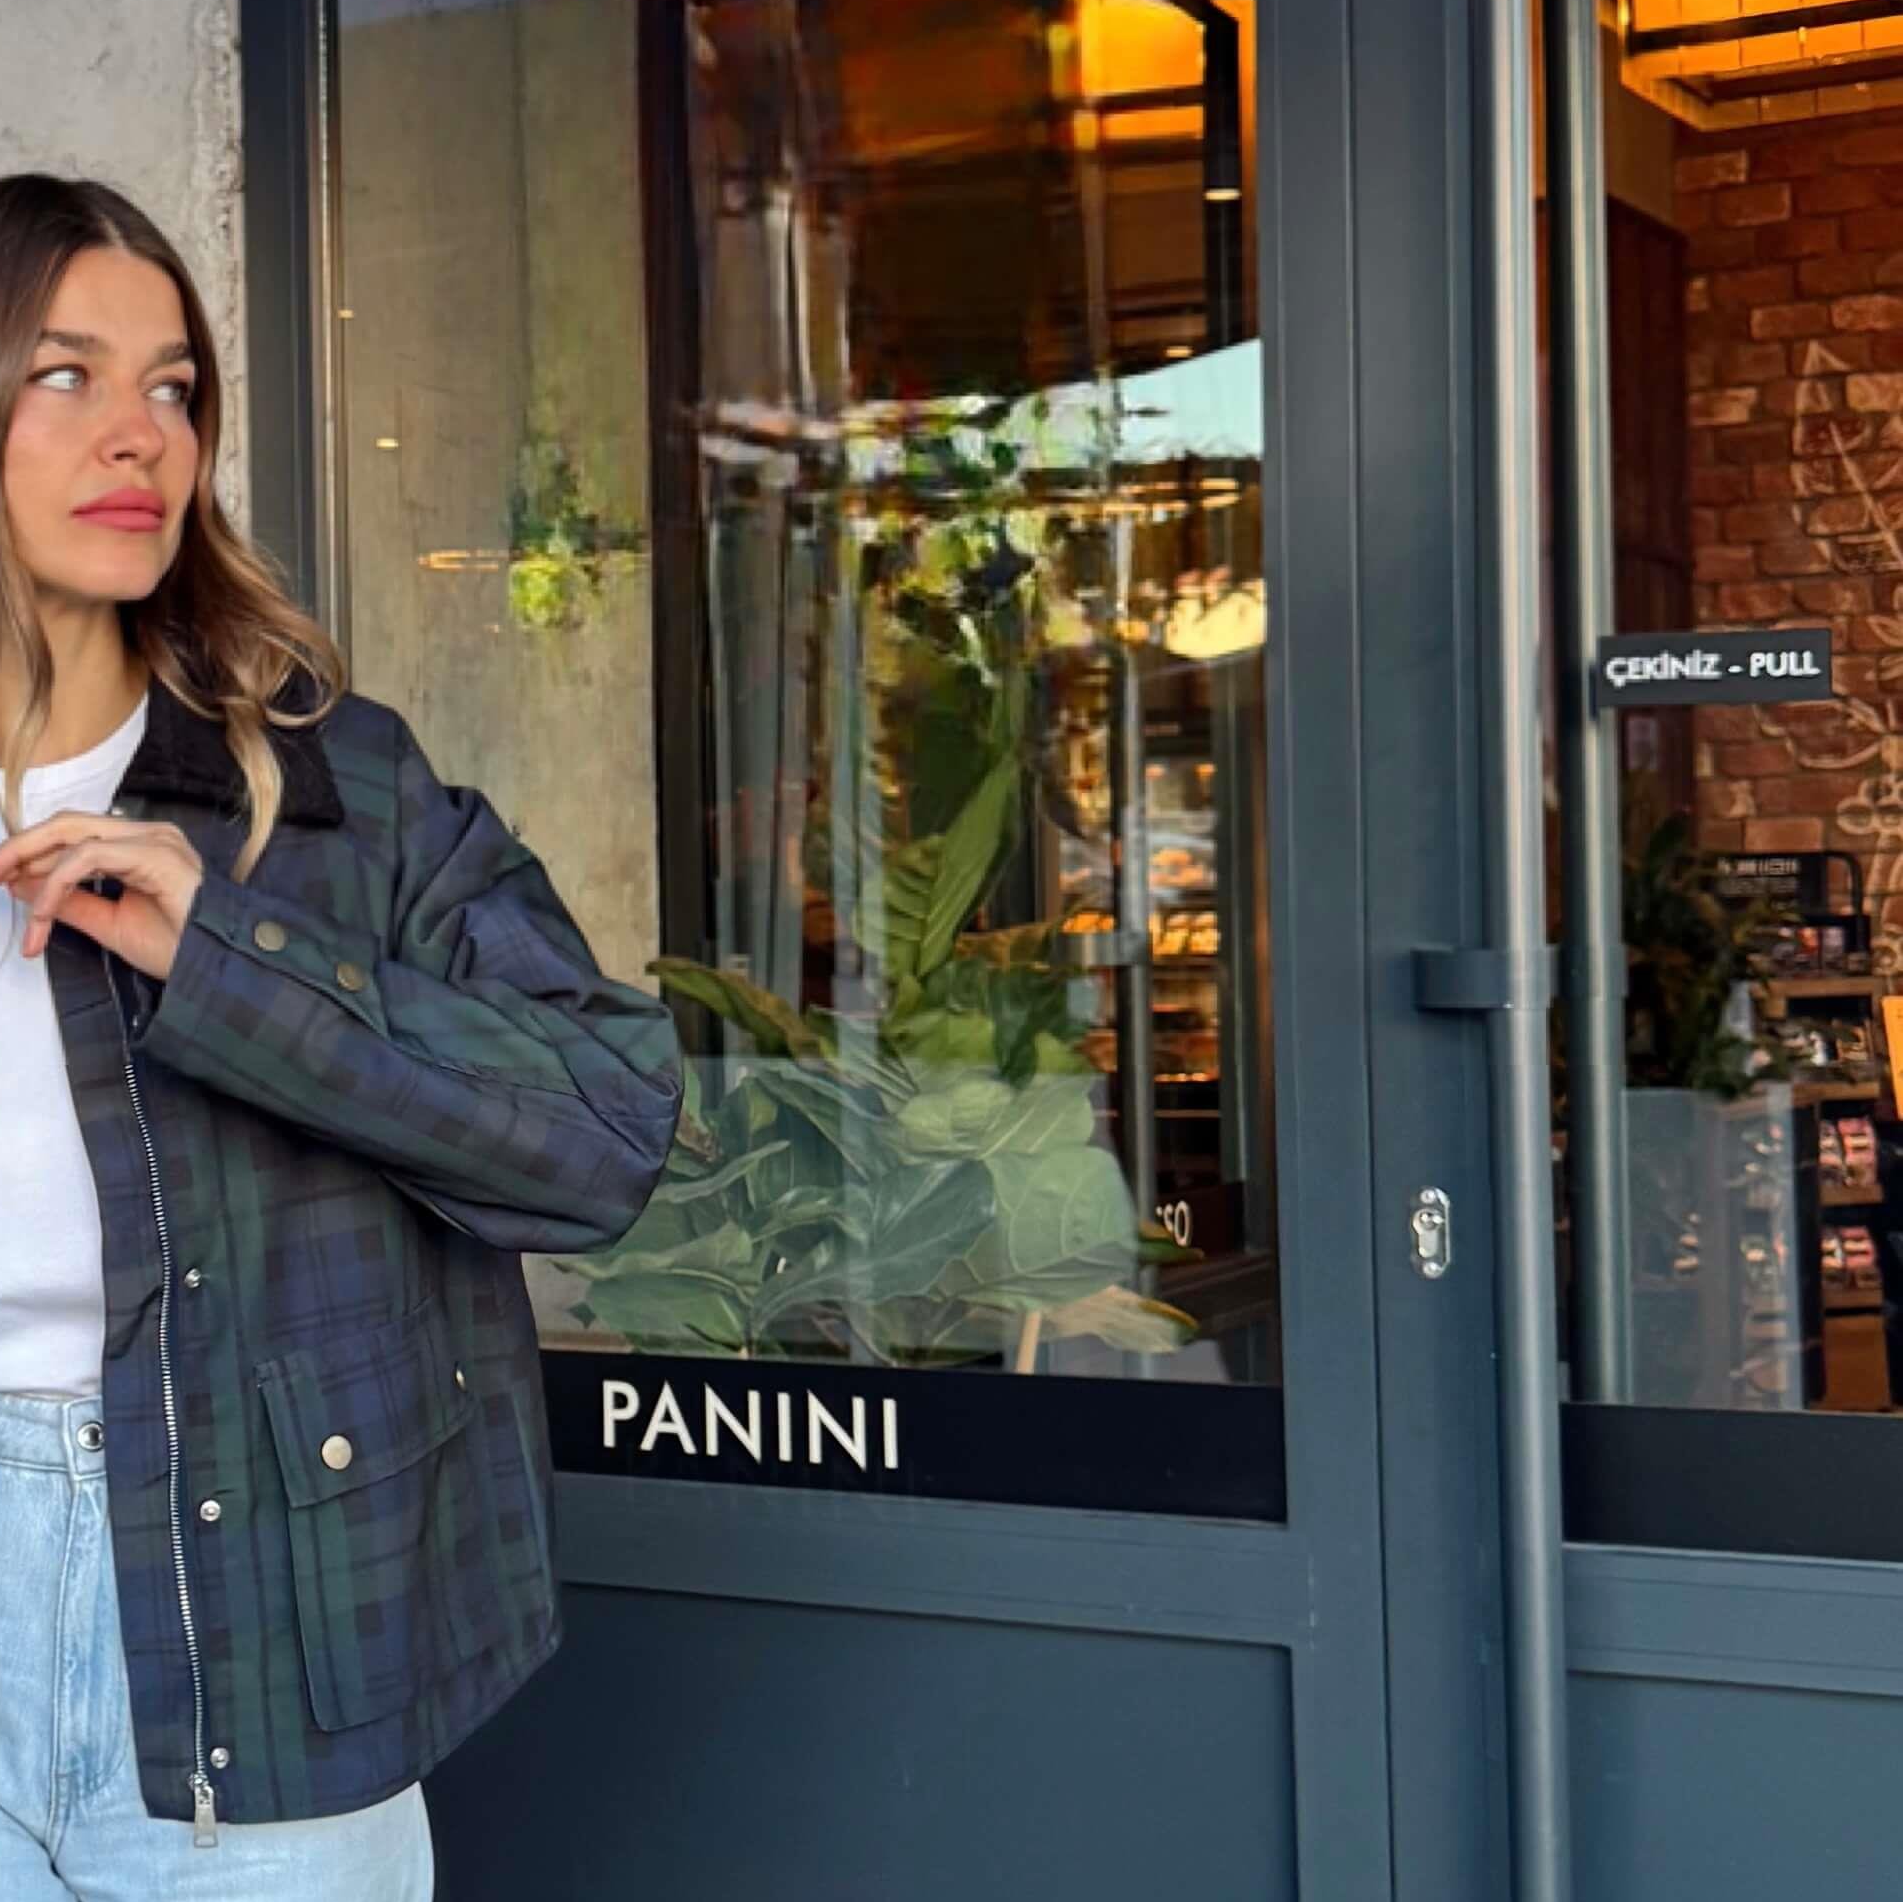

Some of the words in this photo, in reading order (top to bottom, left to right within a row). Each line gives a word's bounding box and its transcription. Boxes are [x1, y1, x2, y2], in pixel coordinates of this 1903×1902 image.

[1605, 649, 1723, 688] ÇEKİNİZ
[1749, 650, 1822, 678] PULL
[602, 1379, 899, 1470] PANINI
